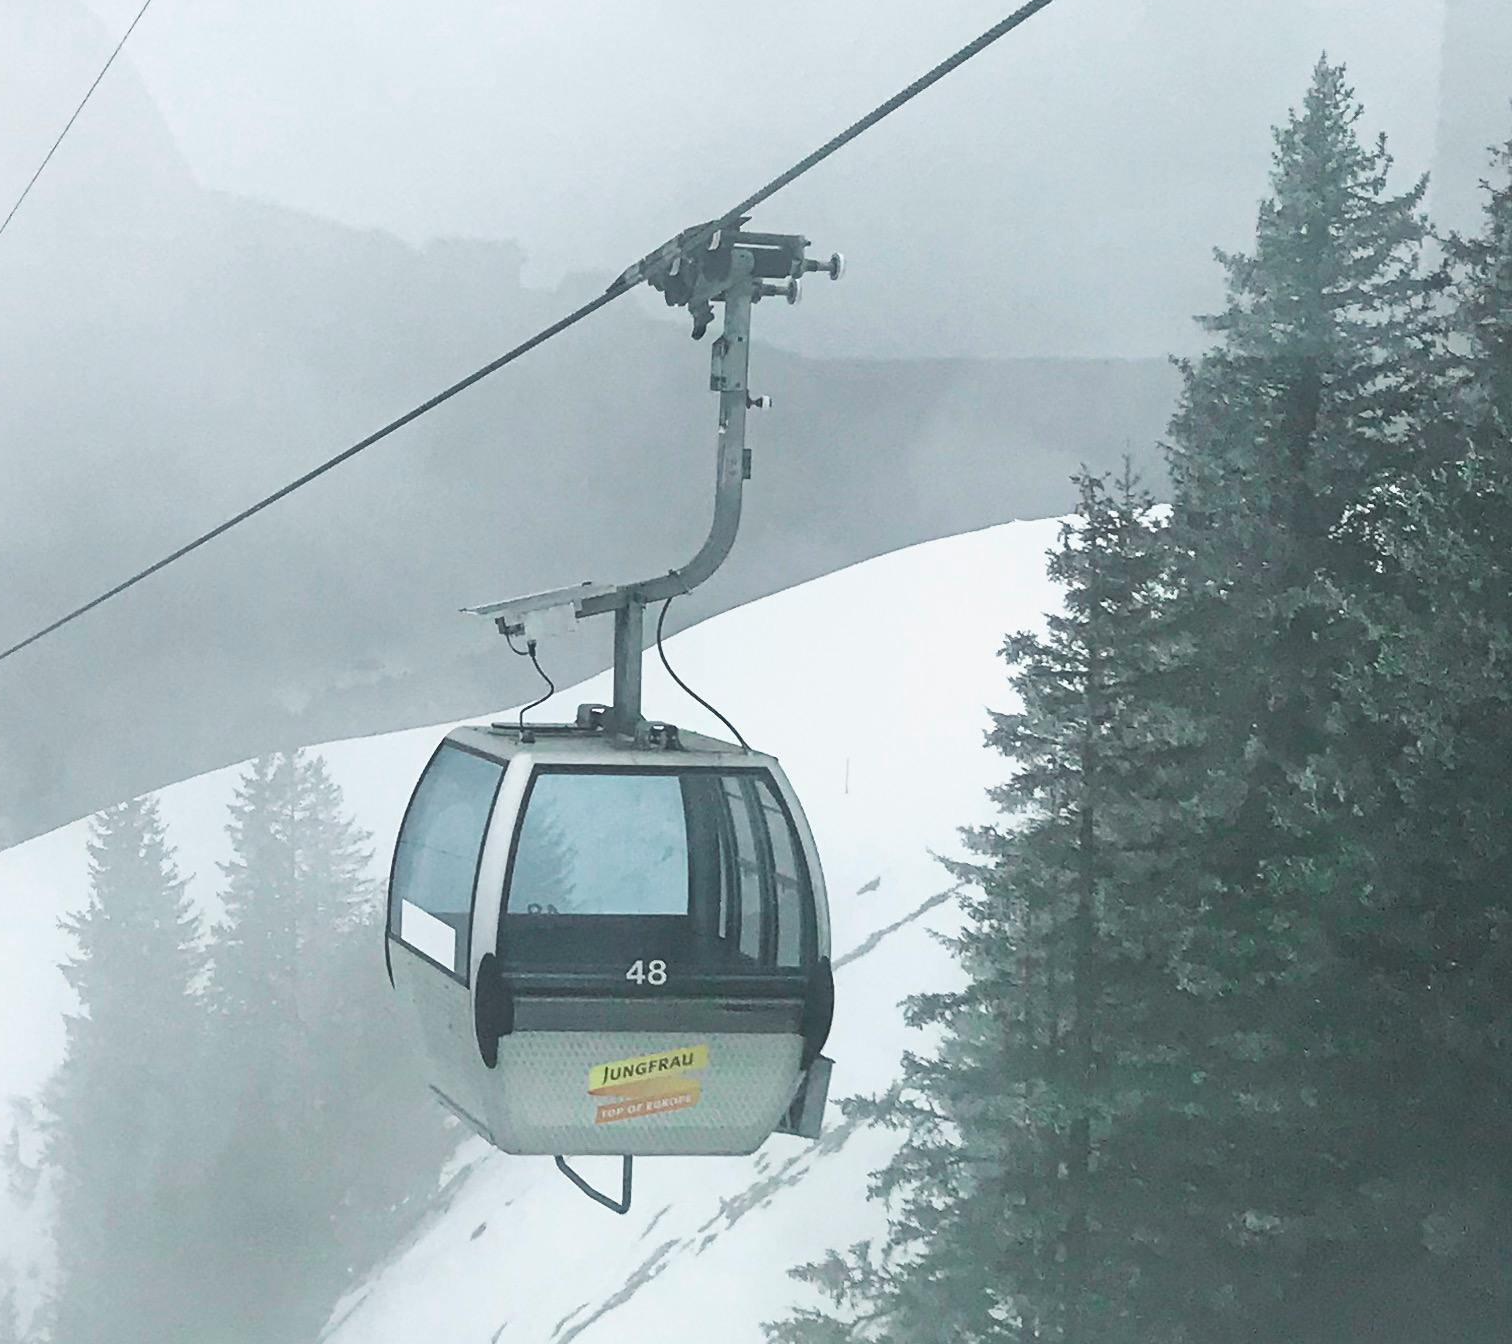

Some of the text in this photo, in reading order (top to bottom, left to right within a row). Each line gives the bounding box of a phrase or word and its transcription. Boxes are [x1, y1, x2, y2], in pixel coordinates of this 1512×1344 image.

[625, 959, 667, 985] 48
[602, 1053, 694, 1085] JUNGFRAU
[601, 1107, 624, 1119] TOP
[627, 1103, 644, 1114] OF
